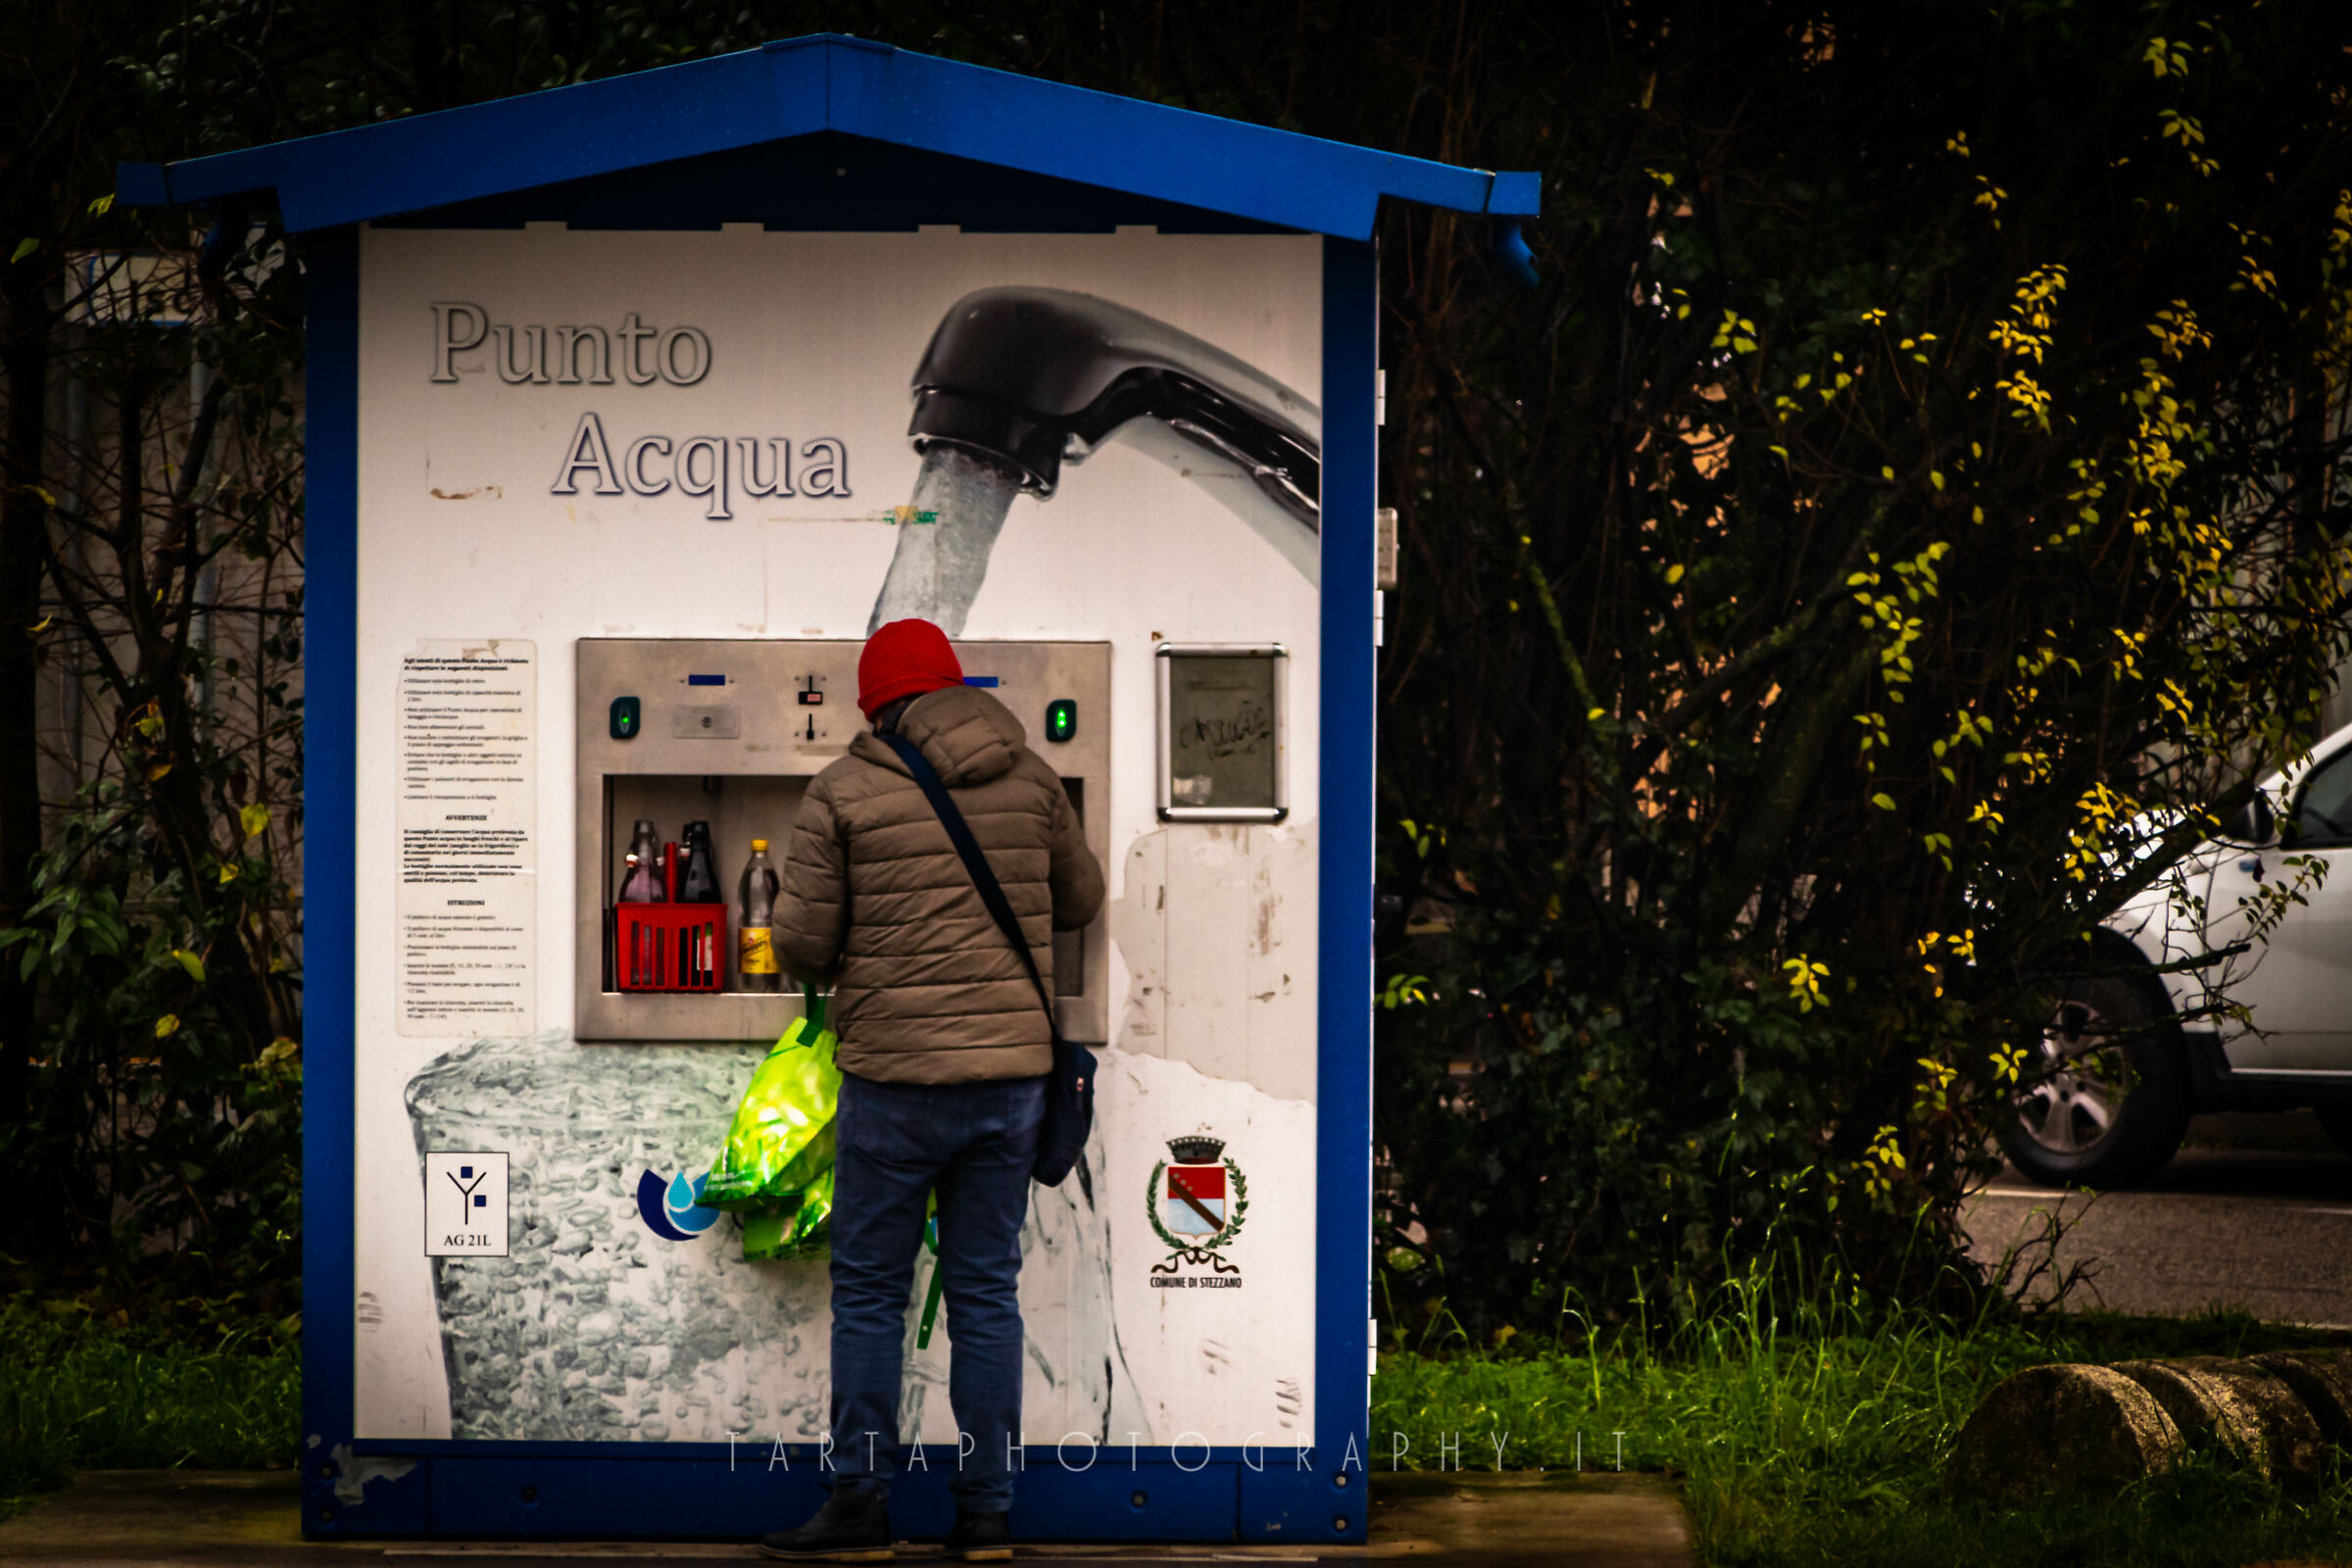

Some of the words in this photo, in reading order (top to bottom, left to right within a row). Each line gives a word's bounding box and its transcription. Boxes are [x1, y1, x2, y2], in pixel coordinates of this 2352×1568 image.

[430, 301, 712, 386] Punto
[550, 411, 852, 521] Acqua
[444, 1234, 465, 1247] AG
[1151, 1277, 1186, 1288] COMUNE
[1188, 1277, 1198, 1288] DI
[1200, 1277, 1242, 1288] STEZZANO
